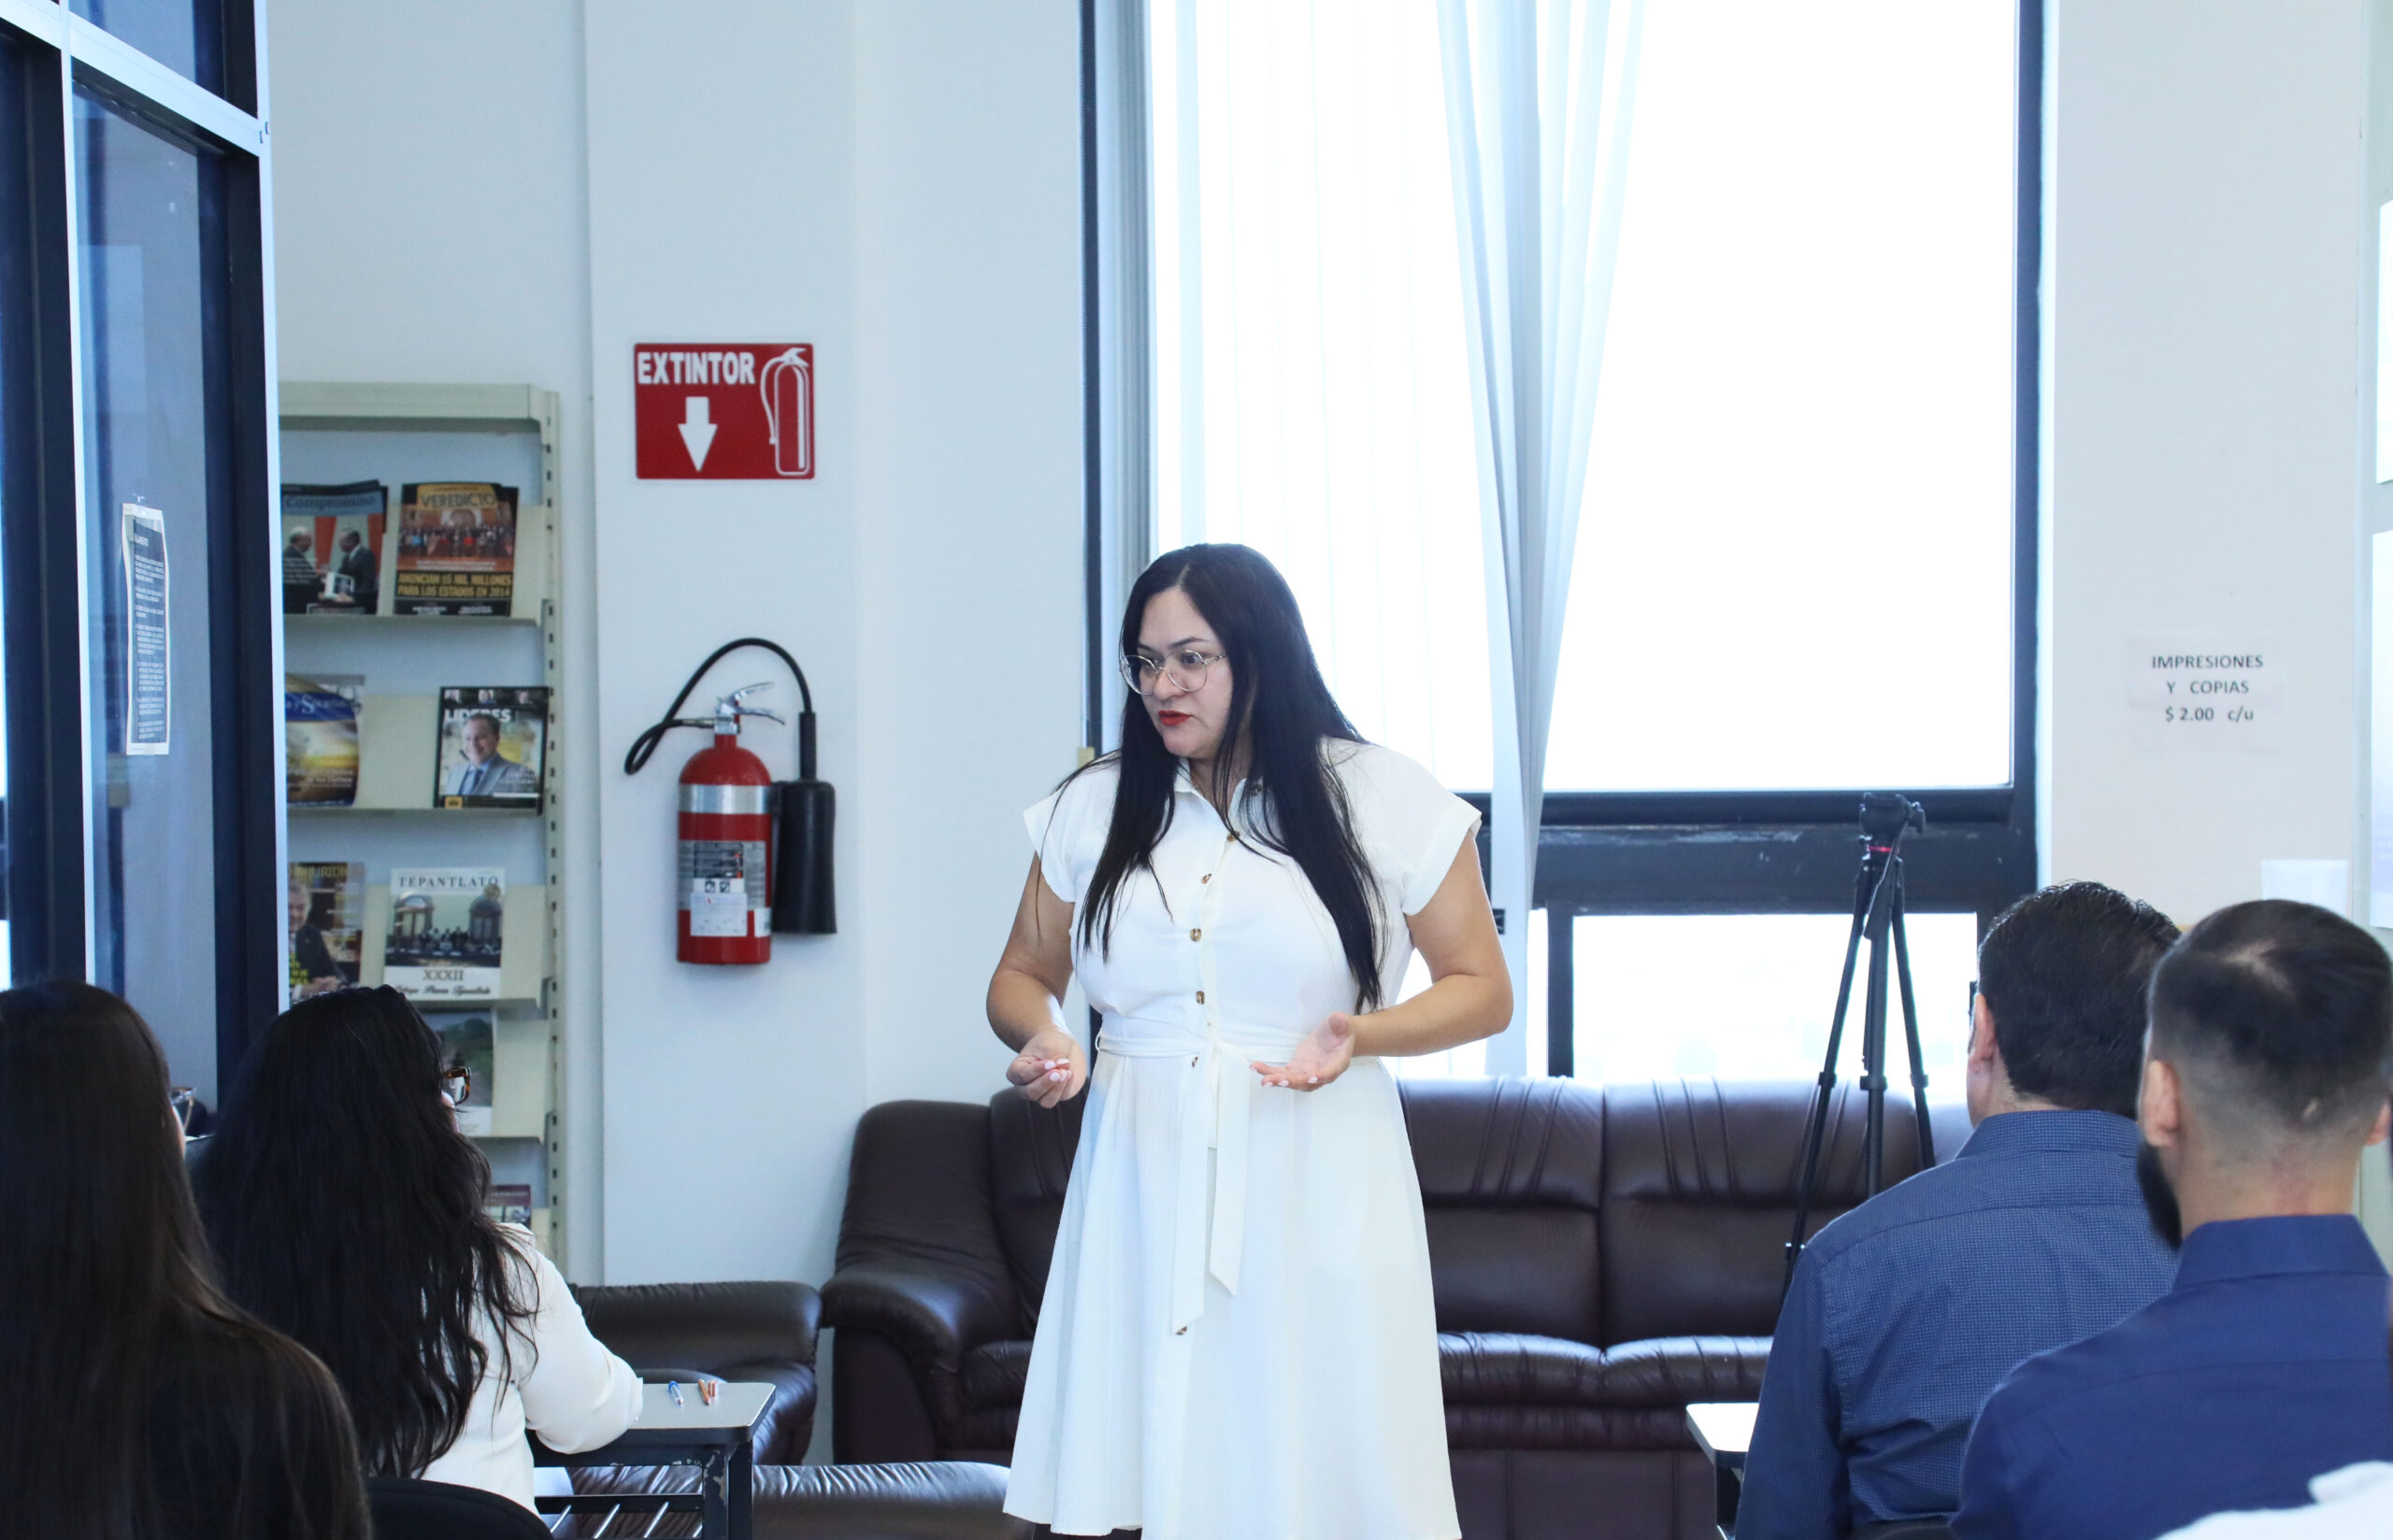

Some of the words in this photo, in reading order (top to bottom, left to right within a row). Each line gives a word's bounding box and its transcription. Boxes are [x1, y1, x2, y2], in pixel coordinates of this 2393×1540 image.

[637, 351, 755, 385] EXTINTOR
[284, 495, 375, 510] Compromiso
[421, 492, 495, 507] VEREDICTO
[398, 573, 439, 584] ANUNCIAN
[453, 574, 467, 584] MIL
[470, 574, 511, 585] MILLONES
[397, 585, 420, 596] PARA
[421, 586, 437, 596] LOS
[438, 586, 474, 596] ESTADOS
[475, 586, 487, 596] EN
[2152, 654, 2263, 668] IMPRESIONES
[2166, 680, 2175, 693] Y
[2189, 680, 2249, 693] COPIAS
[2180, 707, 2214, 720] 2.00
[2228, 706, 2254, 722] c/u
[398, 876, 498, 888] TEPANTLATO
[423, 969, 464, 981] XXXII
